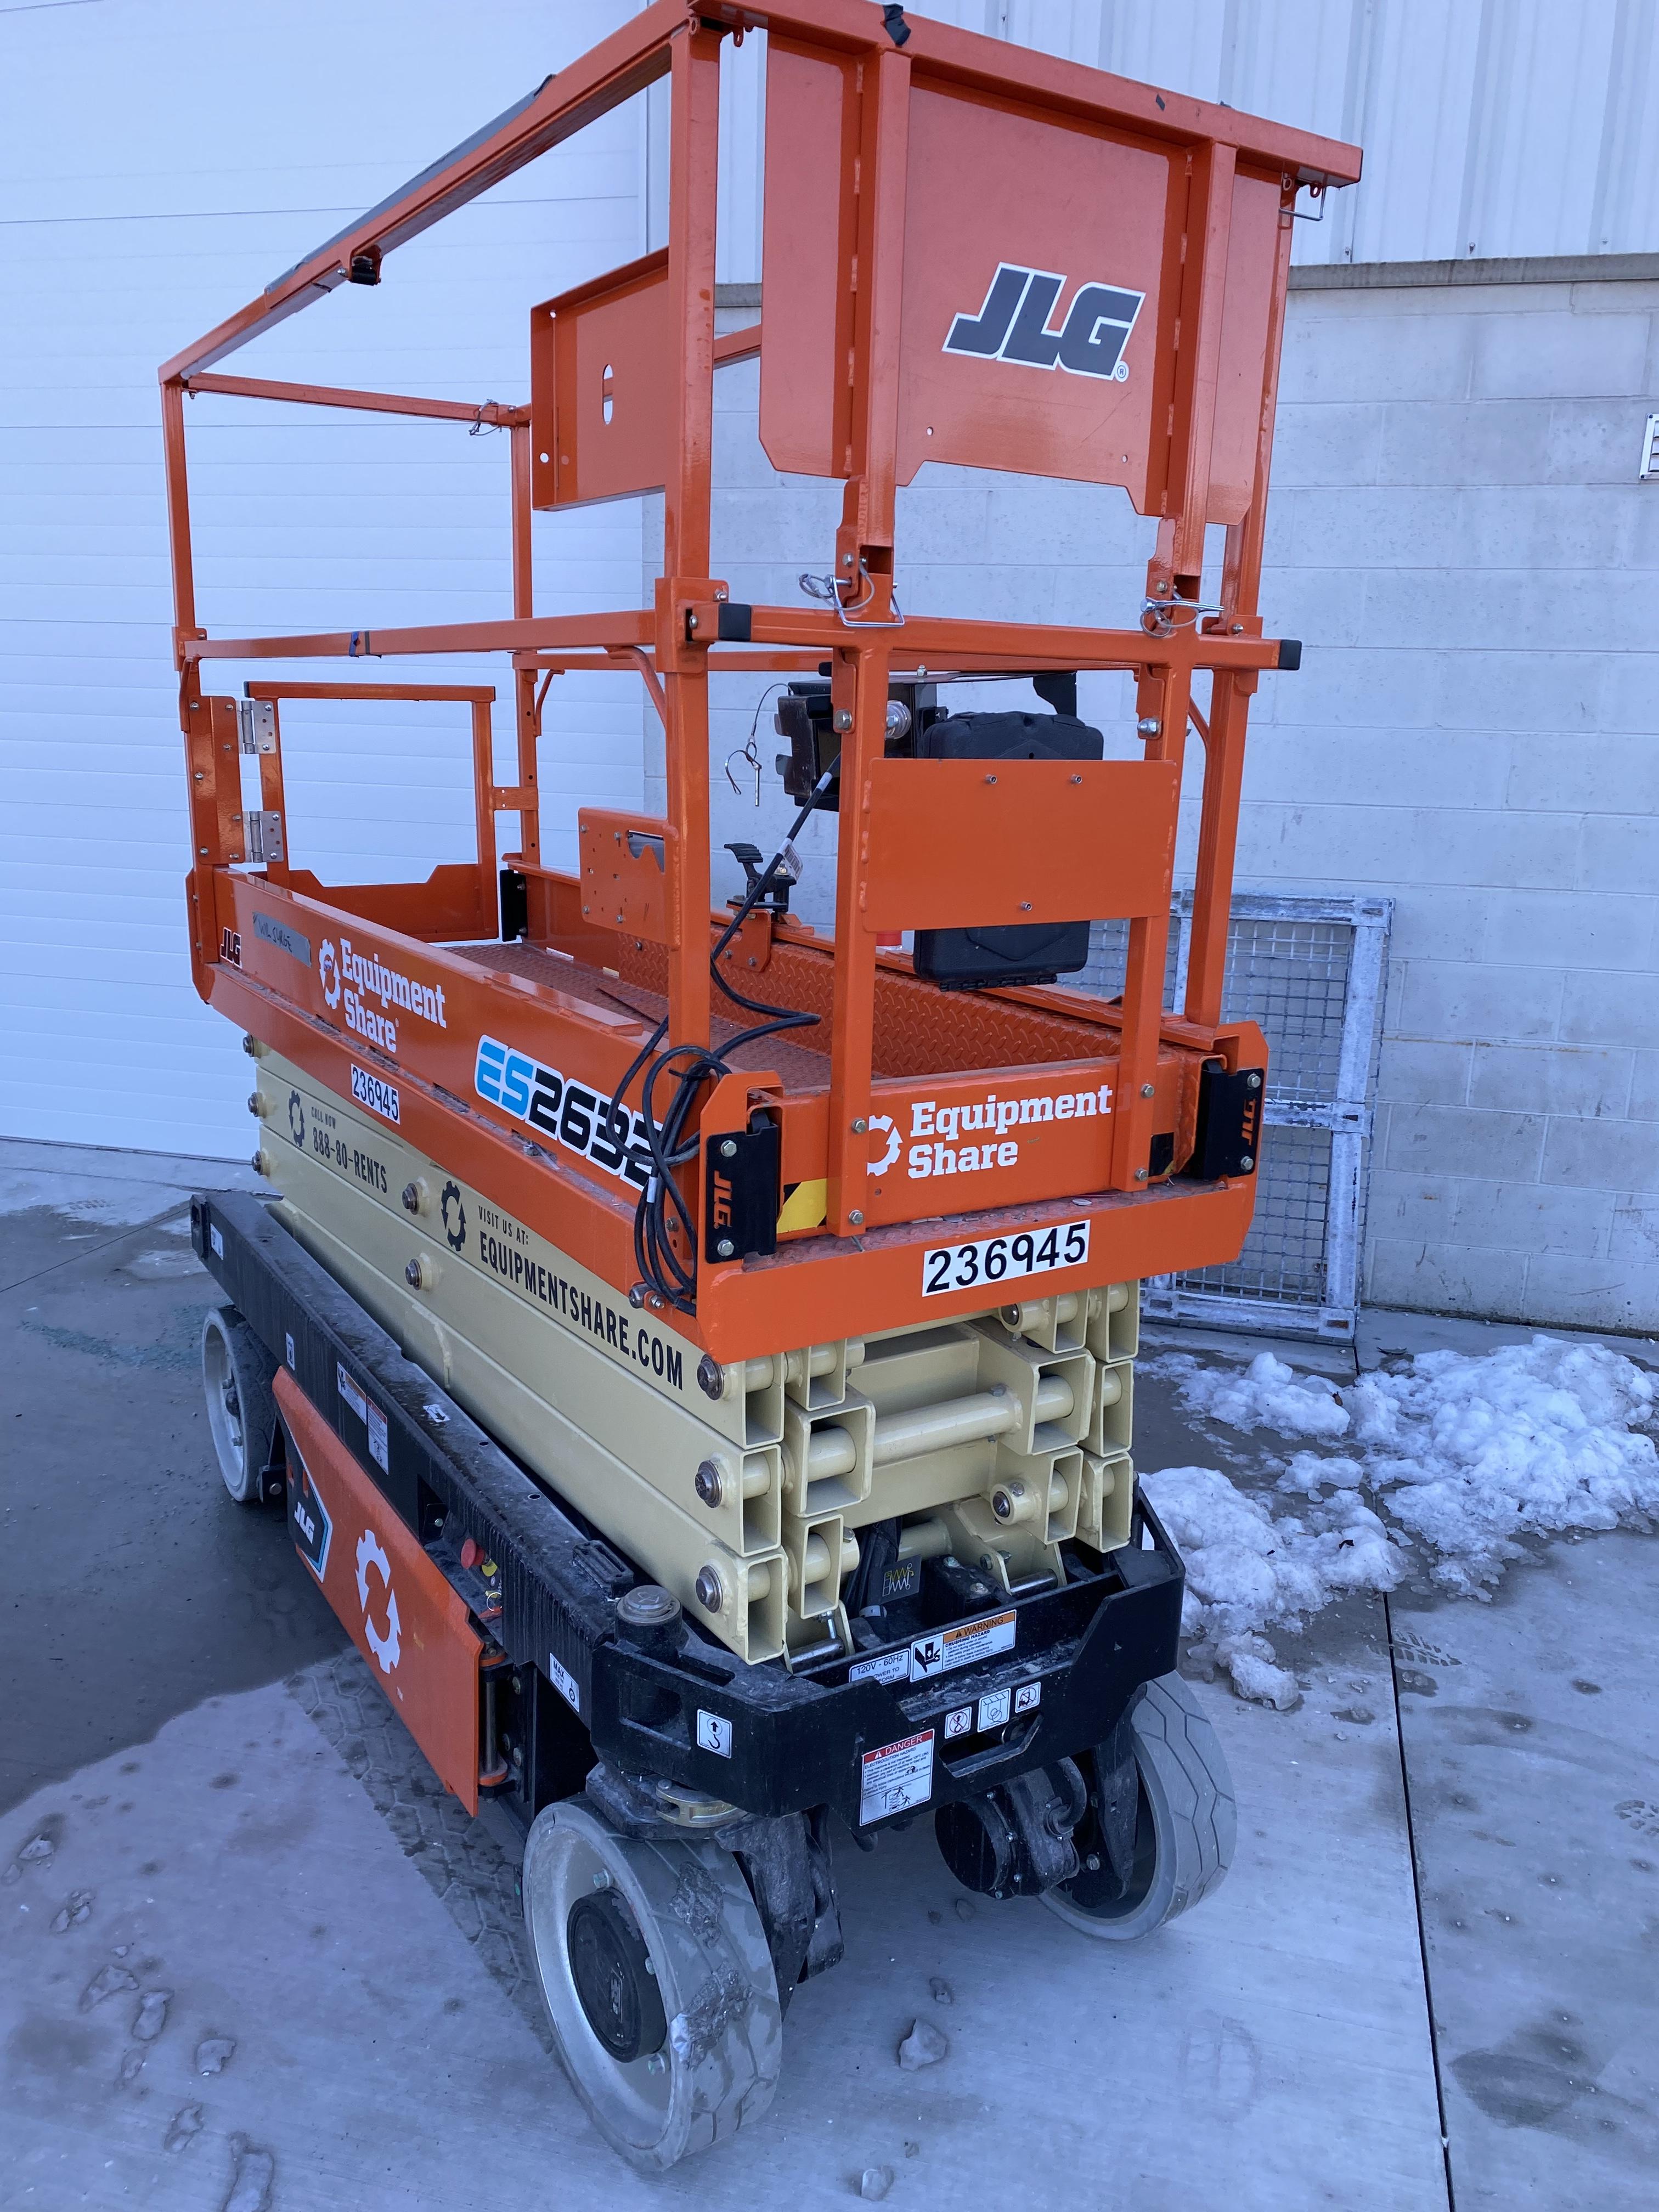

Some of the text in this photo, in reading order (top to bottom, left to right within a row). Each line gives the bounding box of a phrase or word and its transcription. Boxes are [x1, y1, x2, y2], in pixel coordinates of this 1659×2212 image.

[941, 262, 1146, 380] JLG
[220, 927, 241, 968] JLG
[340, 938, 447, 1029] Equipment
[353, 1066, 398, 1121] 236945
[910, 1085, 1113, 1141] Equipment
[312, 1107, 336, 1129] CALL NOW
[1242, 1099, 1256, 1146] JLG
[313, 1127, 387, 1193] 888-80-RENTS
[908, 1141, 1018, 1179] Share
[714, 1170, 732, 1227] JLG
[478, 1206, 528, 1245] VISIT US AT:
[926, 1223, 1086, 1294] 236945
[479, 1231, 682, 1391] EQUIPMENTSHARE.COM
[294, 1502, 315, 1544] JLG
[964, 1616, 1003, 1635] WARNING
[553, 1660, 565, 1680] MAX
[857, 1662, 877, 1675] 120V
[883, 1655, 904, 1666] 60Hz
[874, 1669, 891, 1679] OWER
[885, 1735, 922, 1755] DANGER
